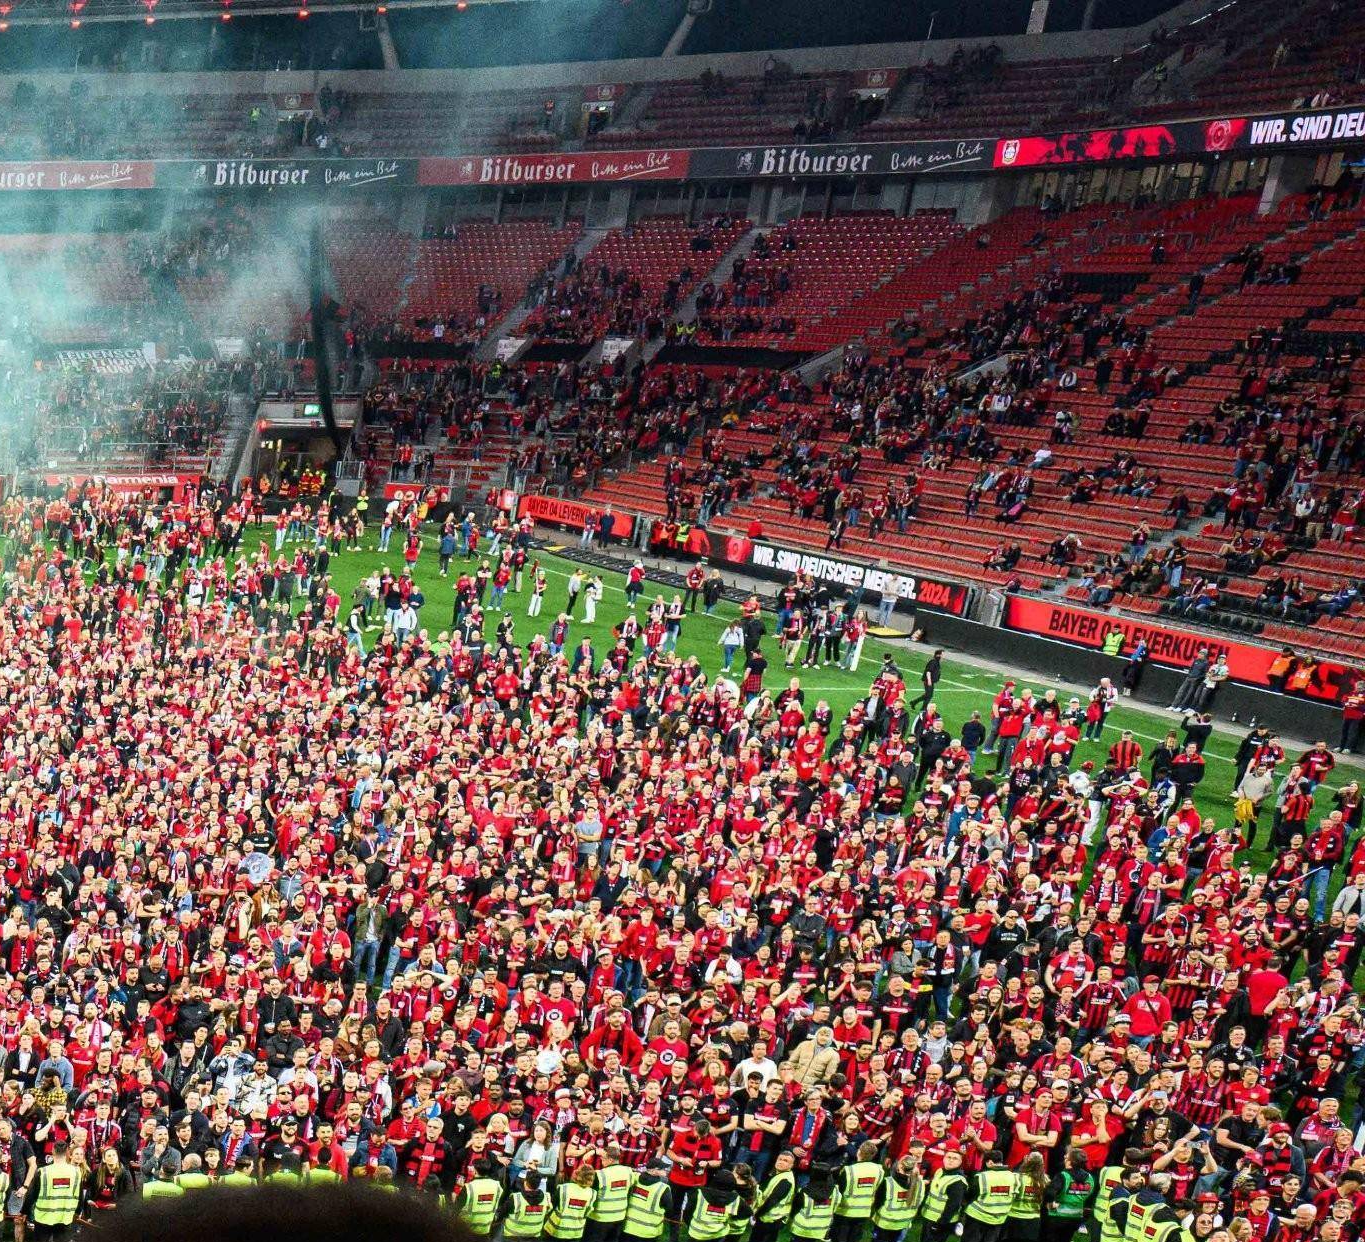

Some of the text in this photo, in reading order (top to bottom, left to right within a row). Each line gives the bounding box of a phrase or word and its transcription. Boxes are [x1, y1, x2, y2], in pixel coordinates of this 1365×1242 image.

[1250, 118, 1287, 145] WIR.
[1289, 115, 1332, 141] SIND
[479, 157, 576, 183] Bitburger
[759, 149, 873, 175] Bitburger
[891, 151, 924, 171] Bitte
[954, 142, 985, 160] Bit
[214, 162, 309, 186] Bitburger
[753, 544, 775, 568] WIR.
[775, 549, 802, 573] SIND
[919, 580, 951, 607] 2024
[1049, 609, 1098, 638] BAYER
